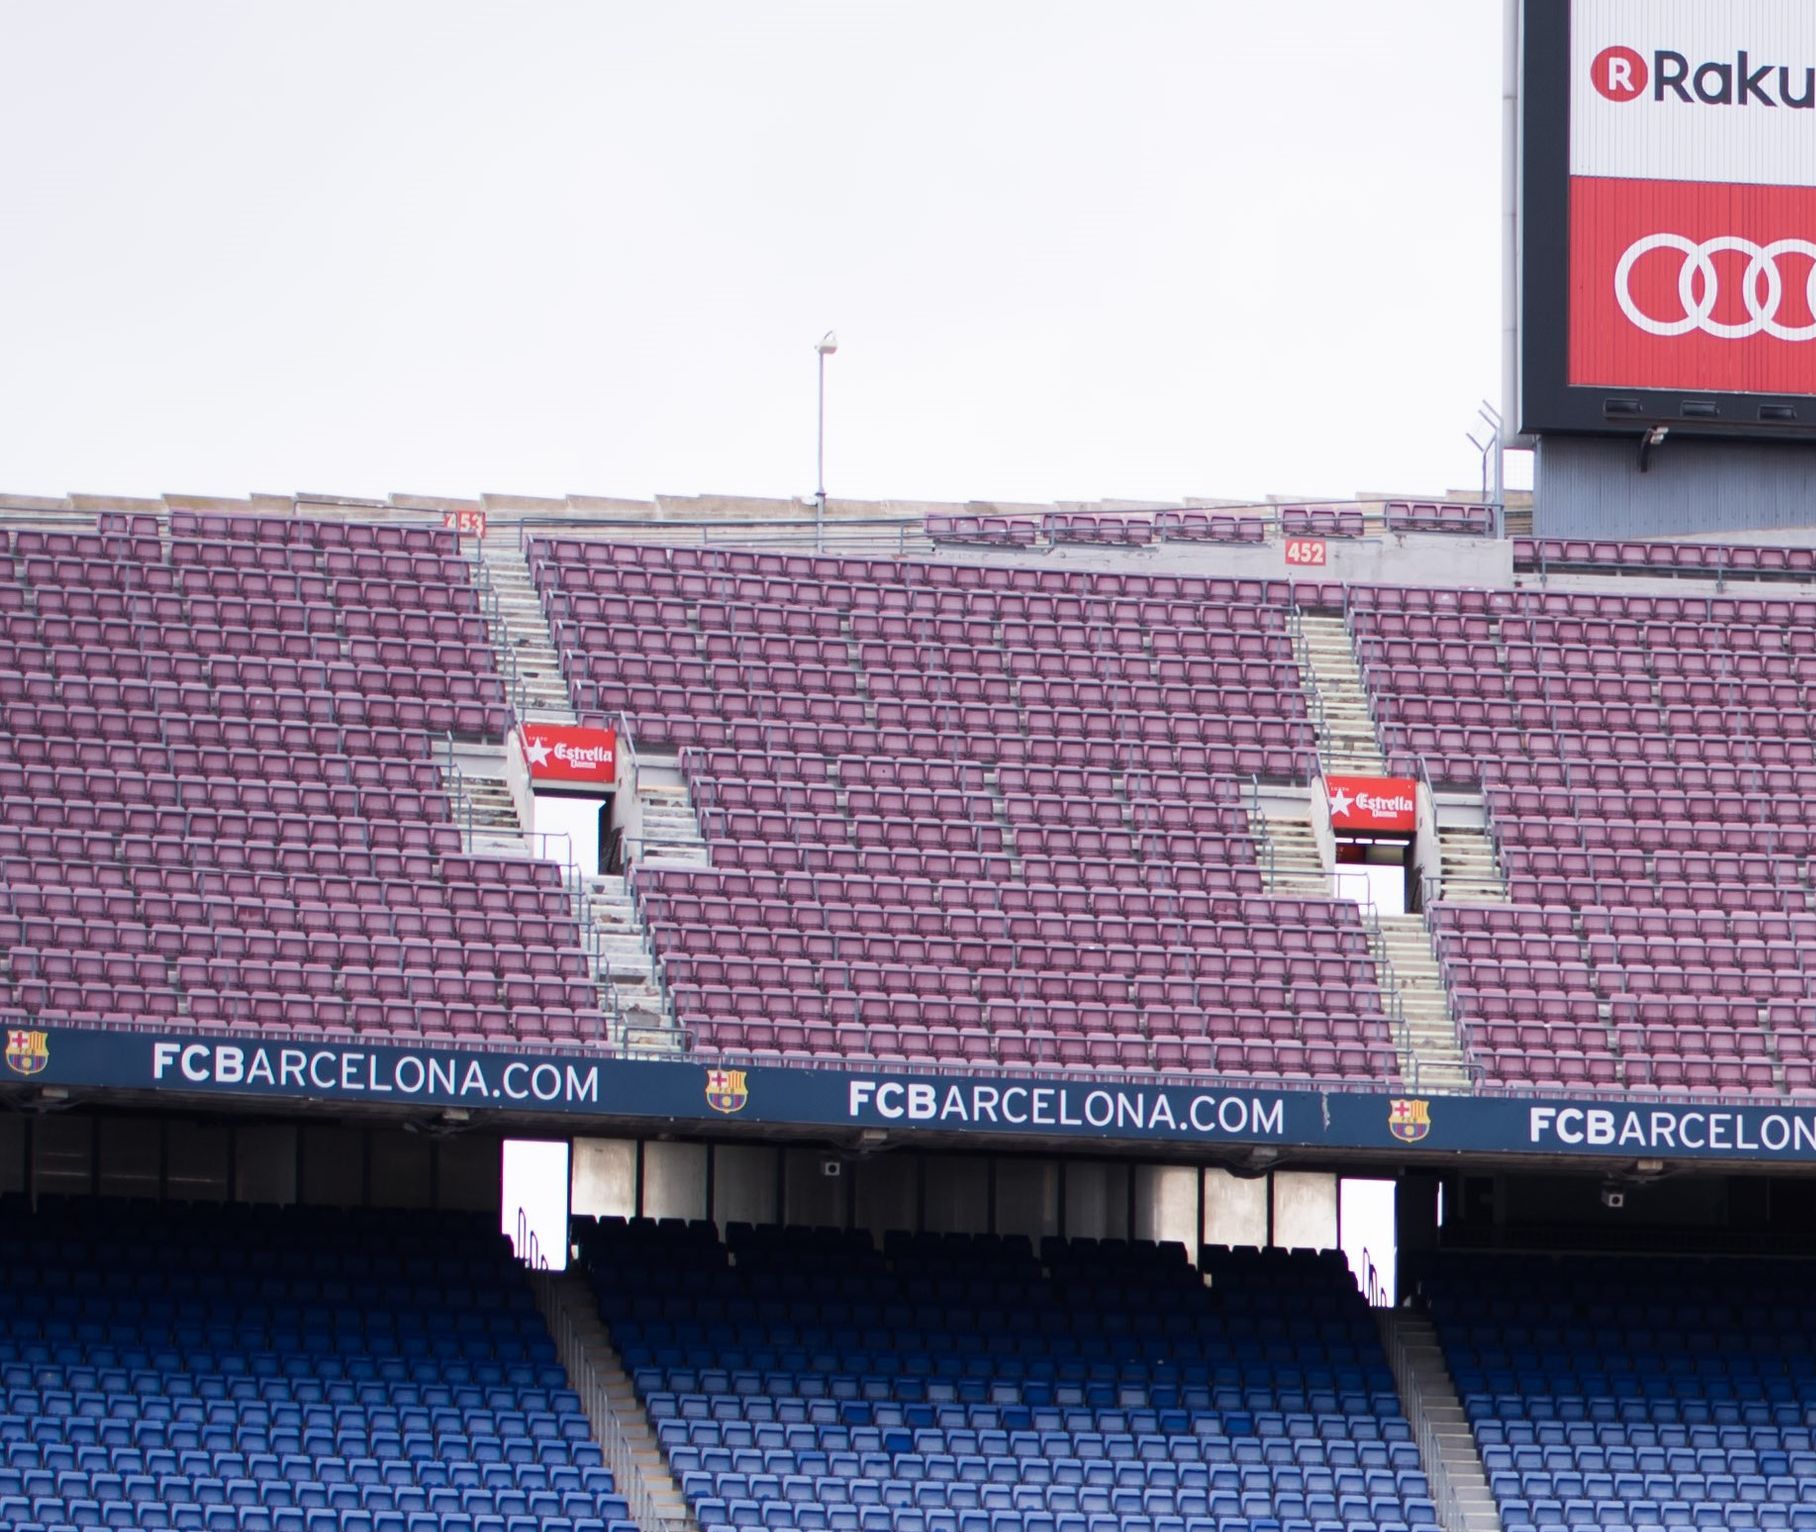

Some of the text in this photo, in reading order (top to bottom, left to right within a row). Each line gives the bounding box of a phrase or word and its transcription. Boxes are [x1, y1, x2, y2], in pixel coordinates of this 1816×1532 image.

[1288, 543, 1323, 562] 452
[554, 743, 612, 762] Estrella
[1356, 793, 1413, 812] Estrella
[153, 1043, 598, 1102] FCBARCELONA.COM
[850, 1080, 1283, 1134] FCBARCELONA.COM
